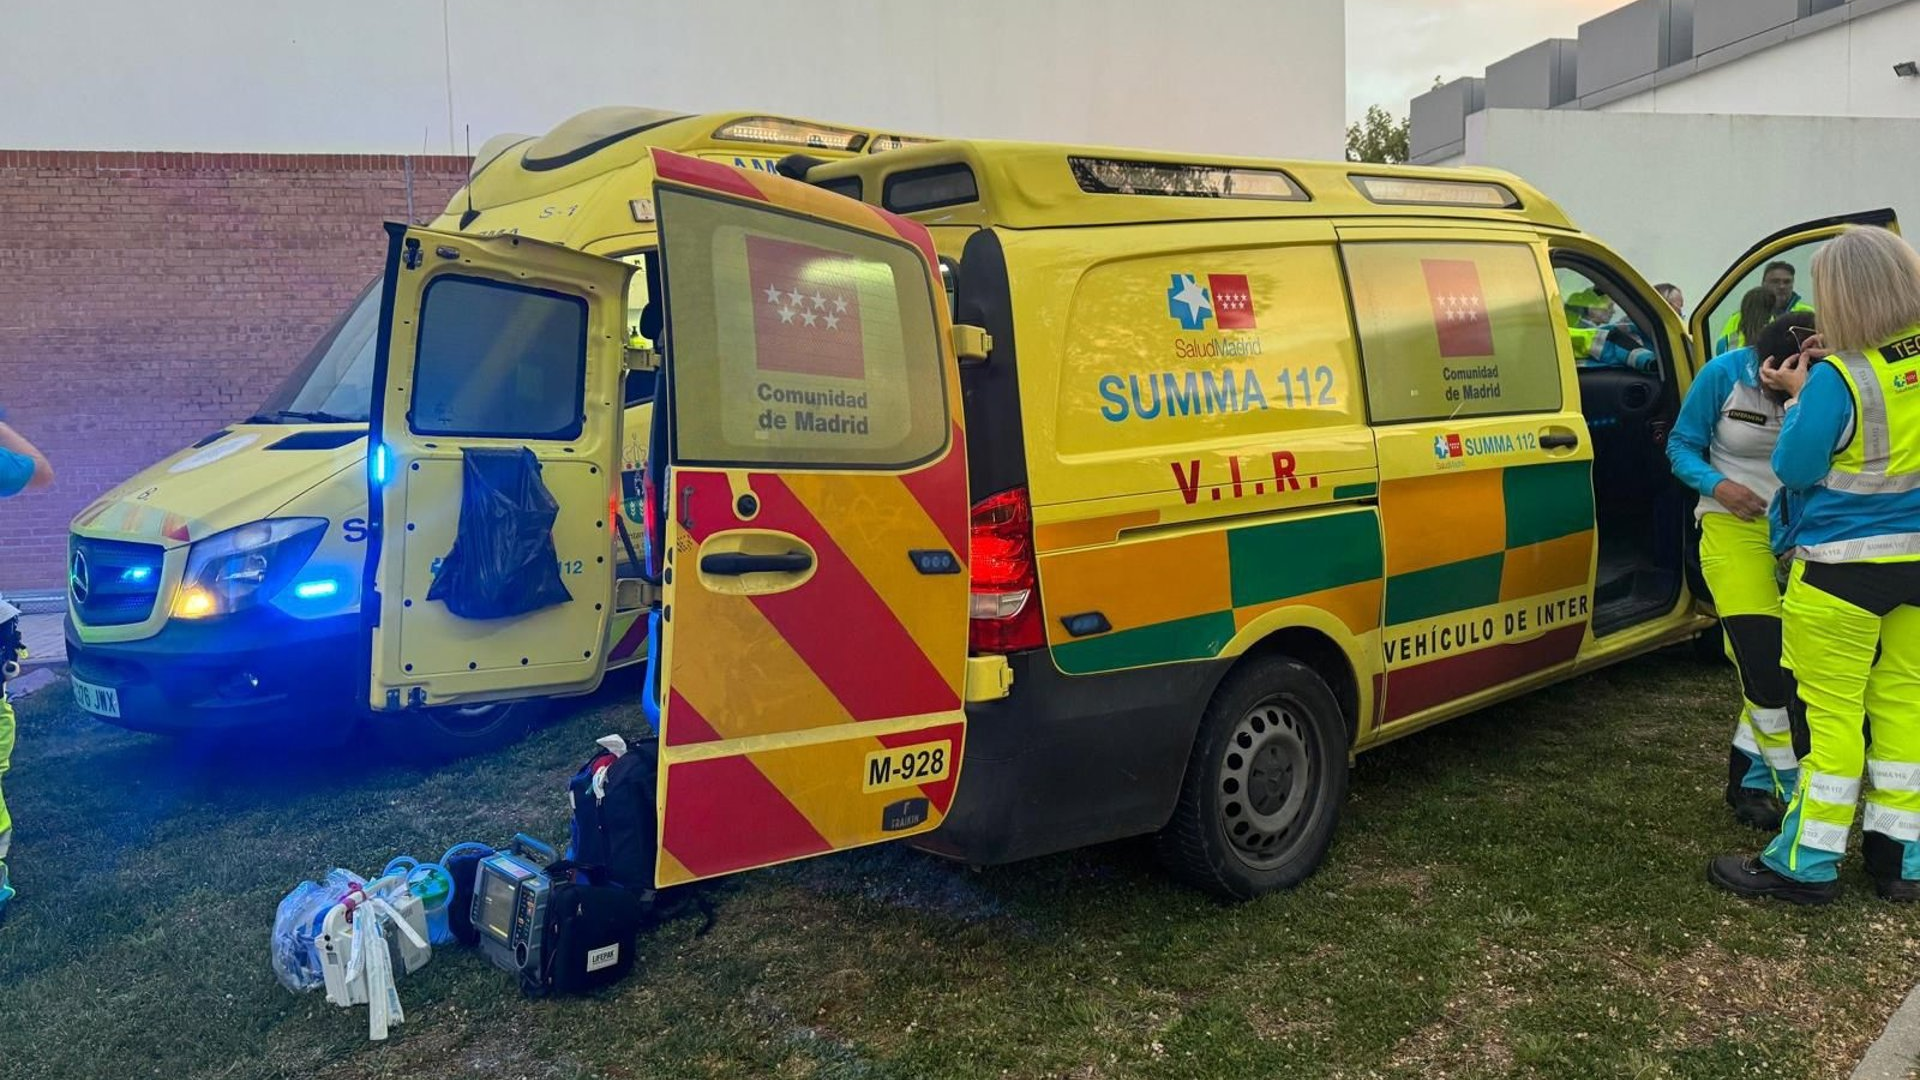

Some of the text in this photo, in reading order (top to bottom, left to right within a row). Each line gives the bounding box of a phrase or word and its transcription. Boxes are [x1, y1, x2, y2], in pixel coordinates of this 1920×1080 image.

[1175, 338, 1262, 358] SaludMadrid
[1442, 365, 1498, 380] Comunidad
[757, 382, 868, 409] Comunidad
[1099, 366, 1337, 423] SUMMA 112
[1445, 383, 1501, 401] de Madrid
[758, 409, 869, 435] de Madrid
[1465, 432, 1536, 456] SUMMA 112
[1171, 450, 1319, 505] V.I.R.
[1384, 595, 1588, 664] VEHÍCULO DE INTER
[94, 688, 116, 713] JWX
[869, 748, 944, 786] M-928
[592, 950, 614, 963] LIFEPAK
